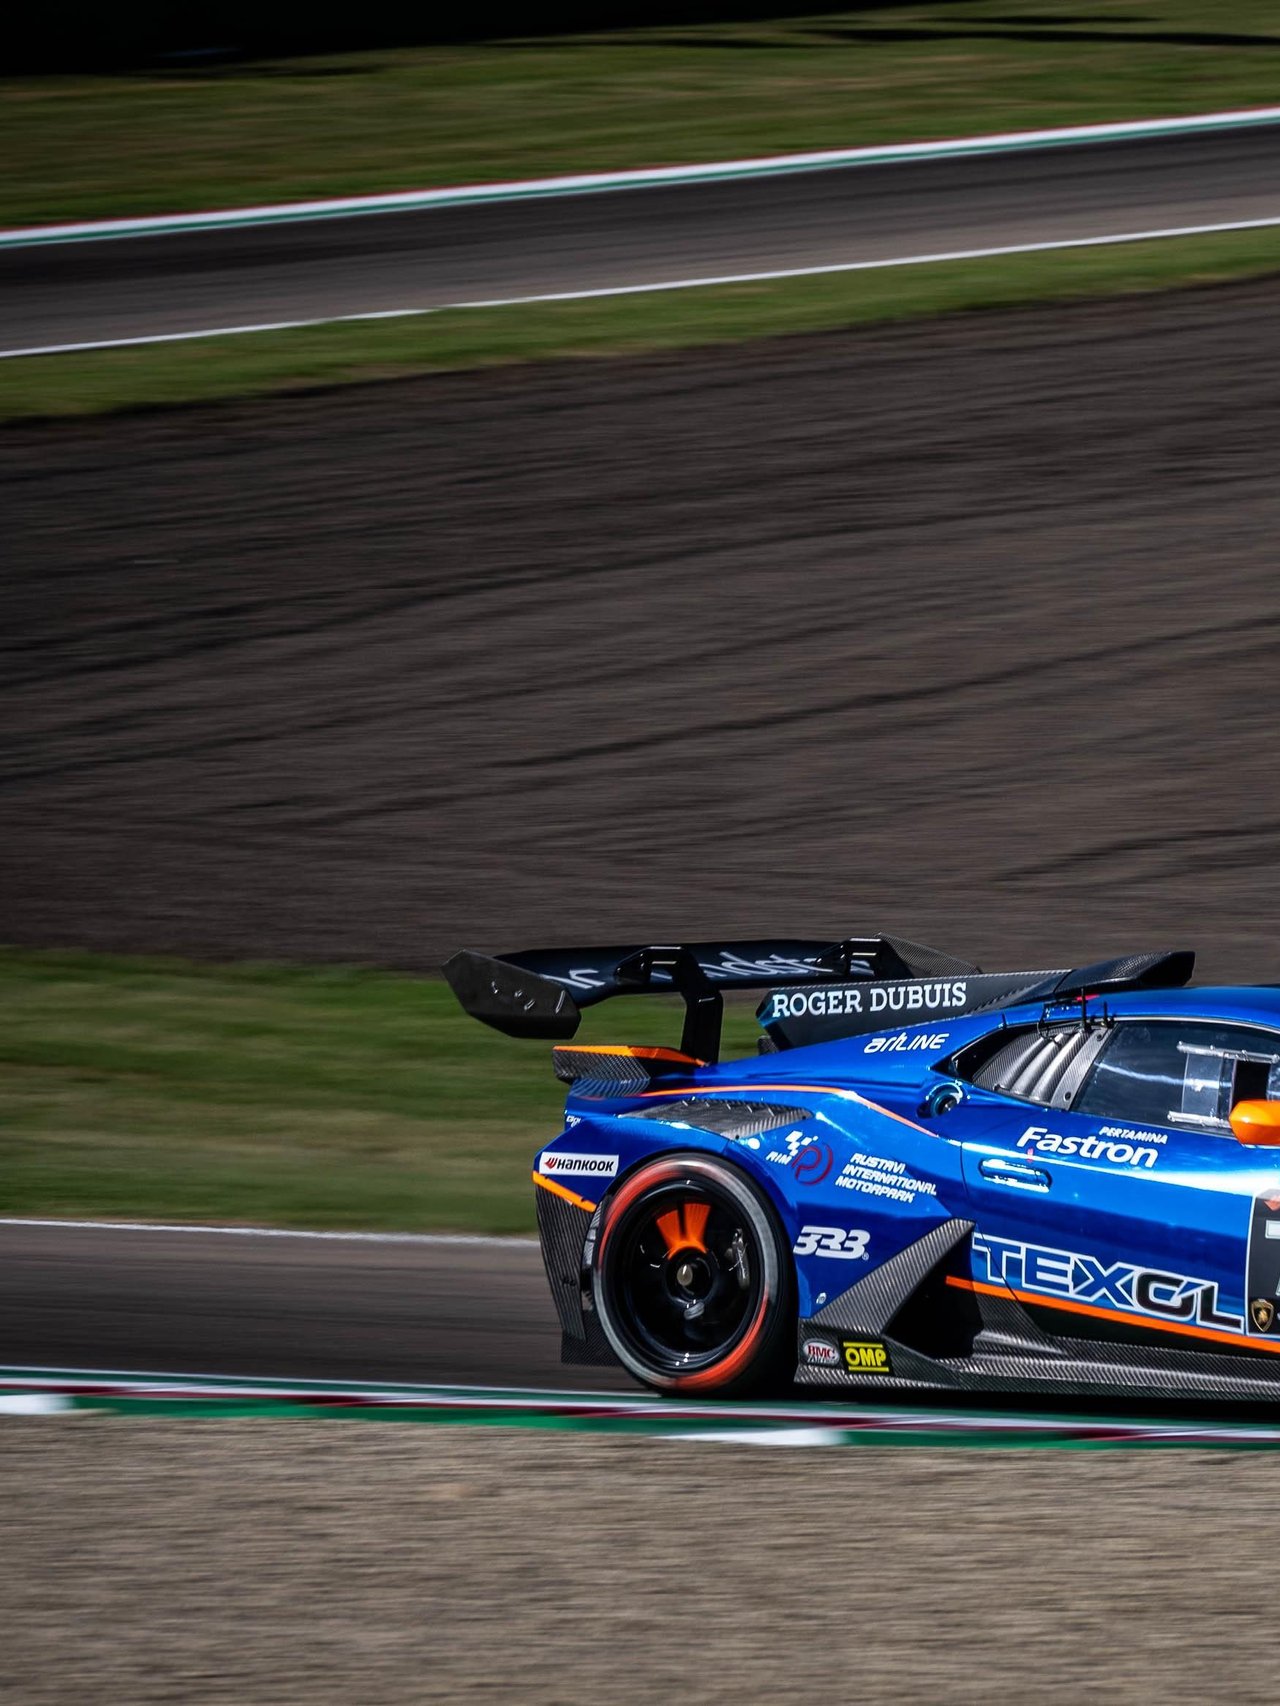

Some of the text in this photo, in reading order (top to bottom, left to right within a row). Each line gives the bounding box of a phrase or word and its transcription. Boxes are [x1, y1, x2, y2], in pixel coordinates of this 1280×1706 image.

[772, 982, 967, 1018] ROGER DUBUIS
[1016, 1126, 1159, 1168] Fastron
[1099, 1126, 1169, 1145] PERTAMINA
[765, 1150, 793, 1166] RIM
[850, 1153, 906, 1174] RUSTAVI
[835, 1176, 916, 1203] MOTORPARK
[842, 1164, 938, 1195] INTERNATIONAL
[845, 1347, 887, 1367] OMP
